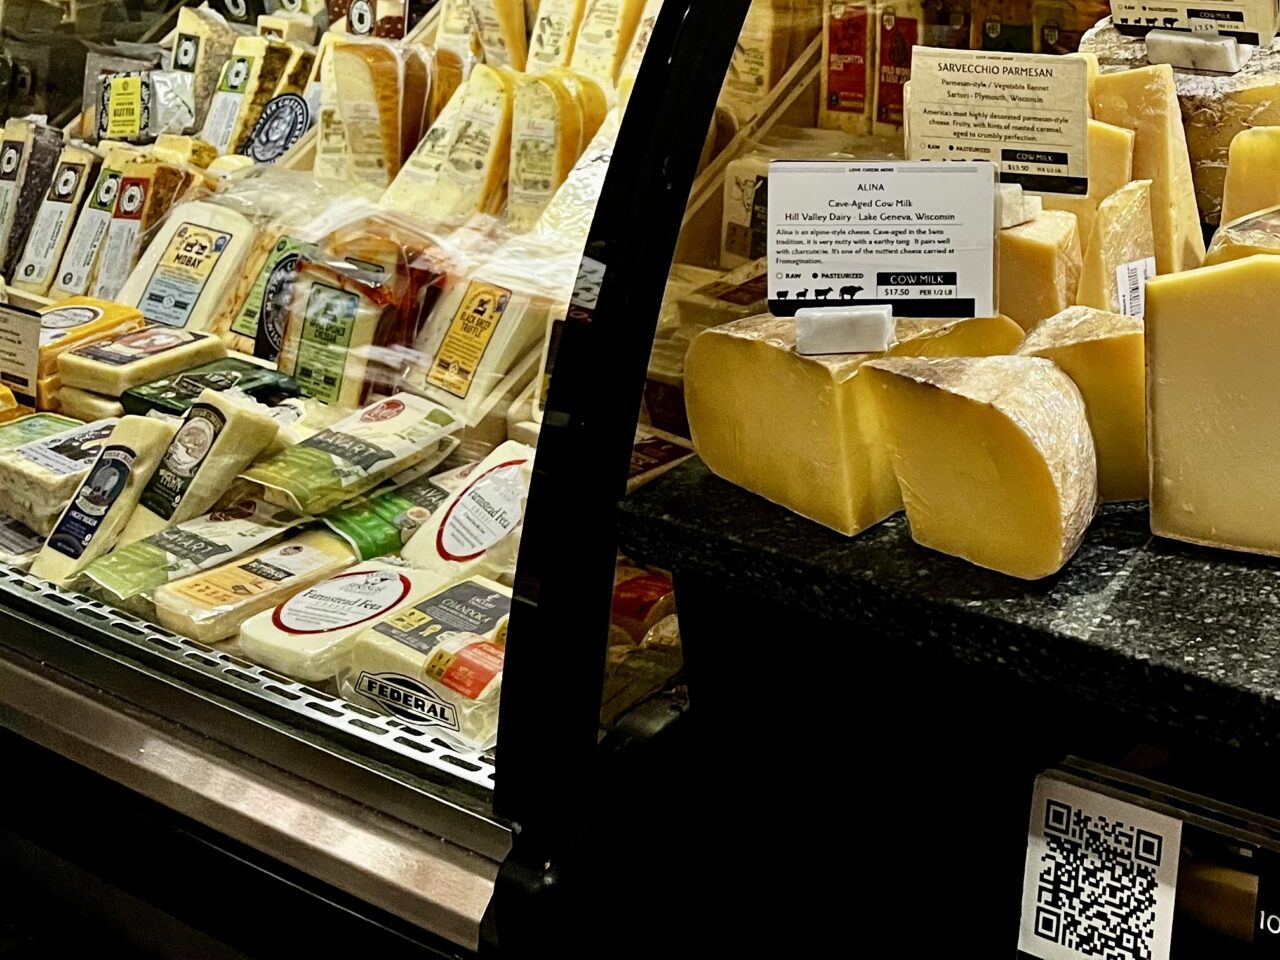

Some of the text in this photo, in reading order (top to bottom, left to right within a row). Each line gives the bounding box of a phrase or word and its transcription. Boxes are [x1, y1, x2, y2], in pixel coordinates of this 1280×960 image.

[938, 63, 1053, 77] SARVECCHIO PARMESAN
[947, 91, 1044, 103] Sartori Plymouth, Wisconsin
[828, 200, 873, 209] Cave-Aged
[785, 213, 955, 222] Hill Valley Dairy Lake Geneva, Wisconsin
[174, 253, 204, 269] MOBAY
[890, 275, 944, 284] COW MILK
[303, 589, 383, 612] Farmstead Feta
[367, 679, 451, 721] FEDERAL
